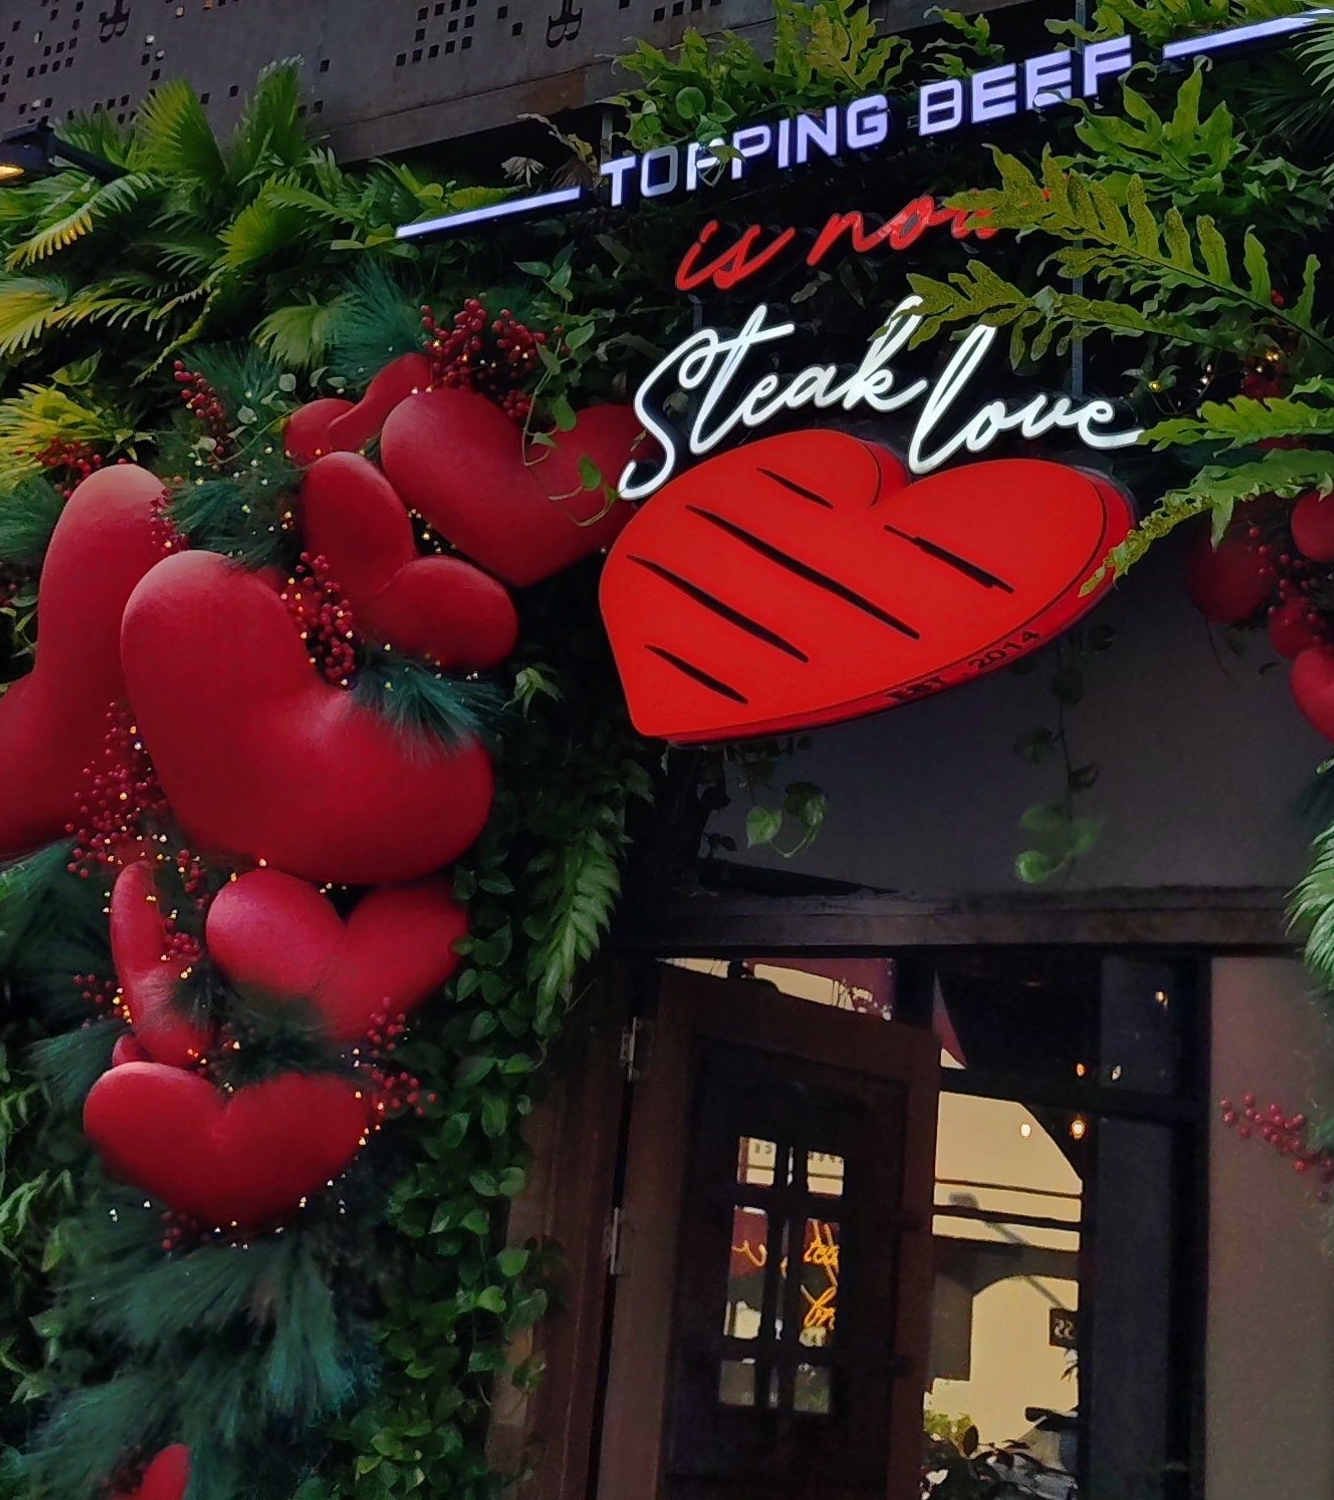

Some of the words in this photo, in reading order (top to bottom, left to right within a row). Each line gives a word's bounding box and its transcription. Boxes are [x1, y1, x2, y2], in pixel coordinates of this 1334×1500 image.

[600, 93, 889, 207] TOPPING
[918, 33, 1132, 137] BEEF
[675, 219, 796, 292] is
[968, 631, 1040, 671] 2014
